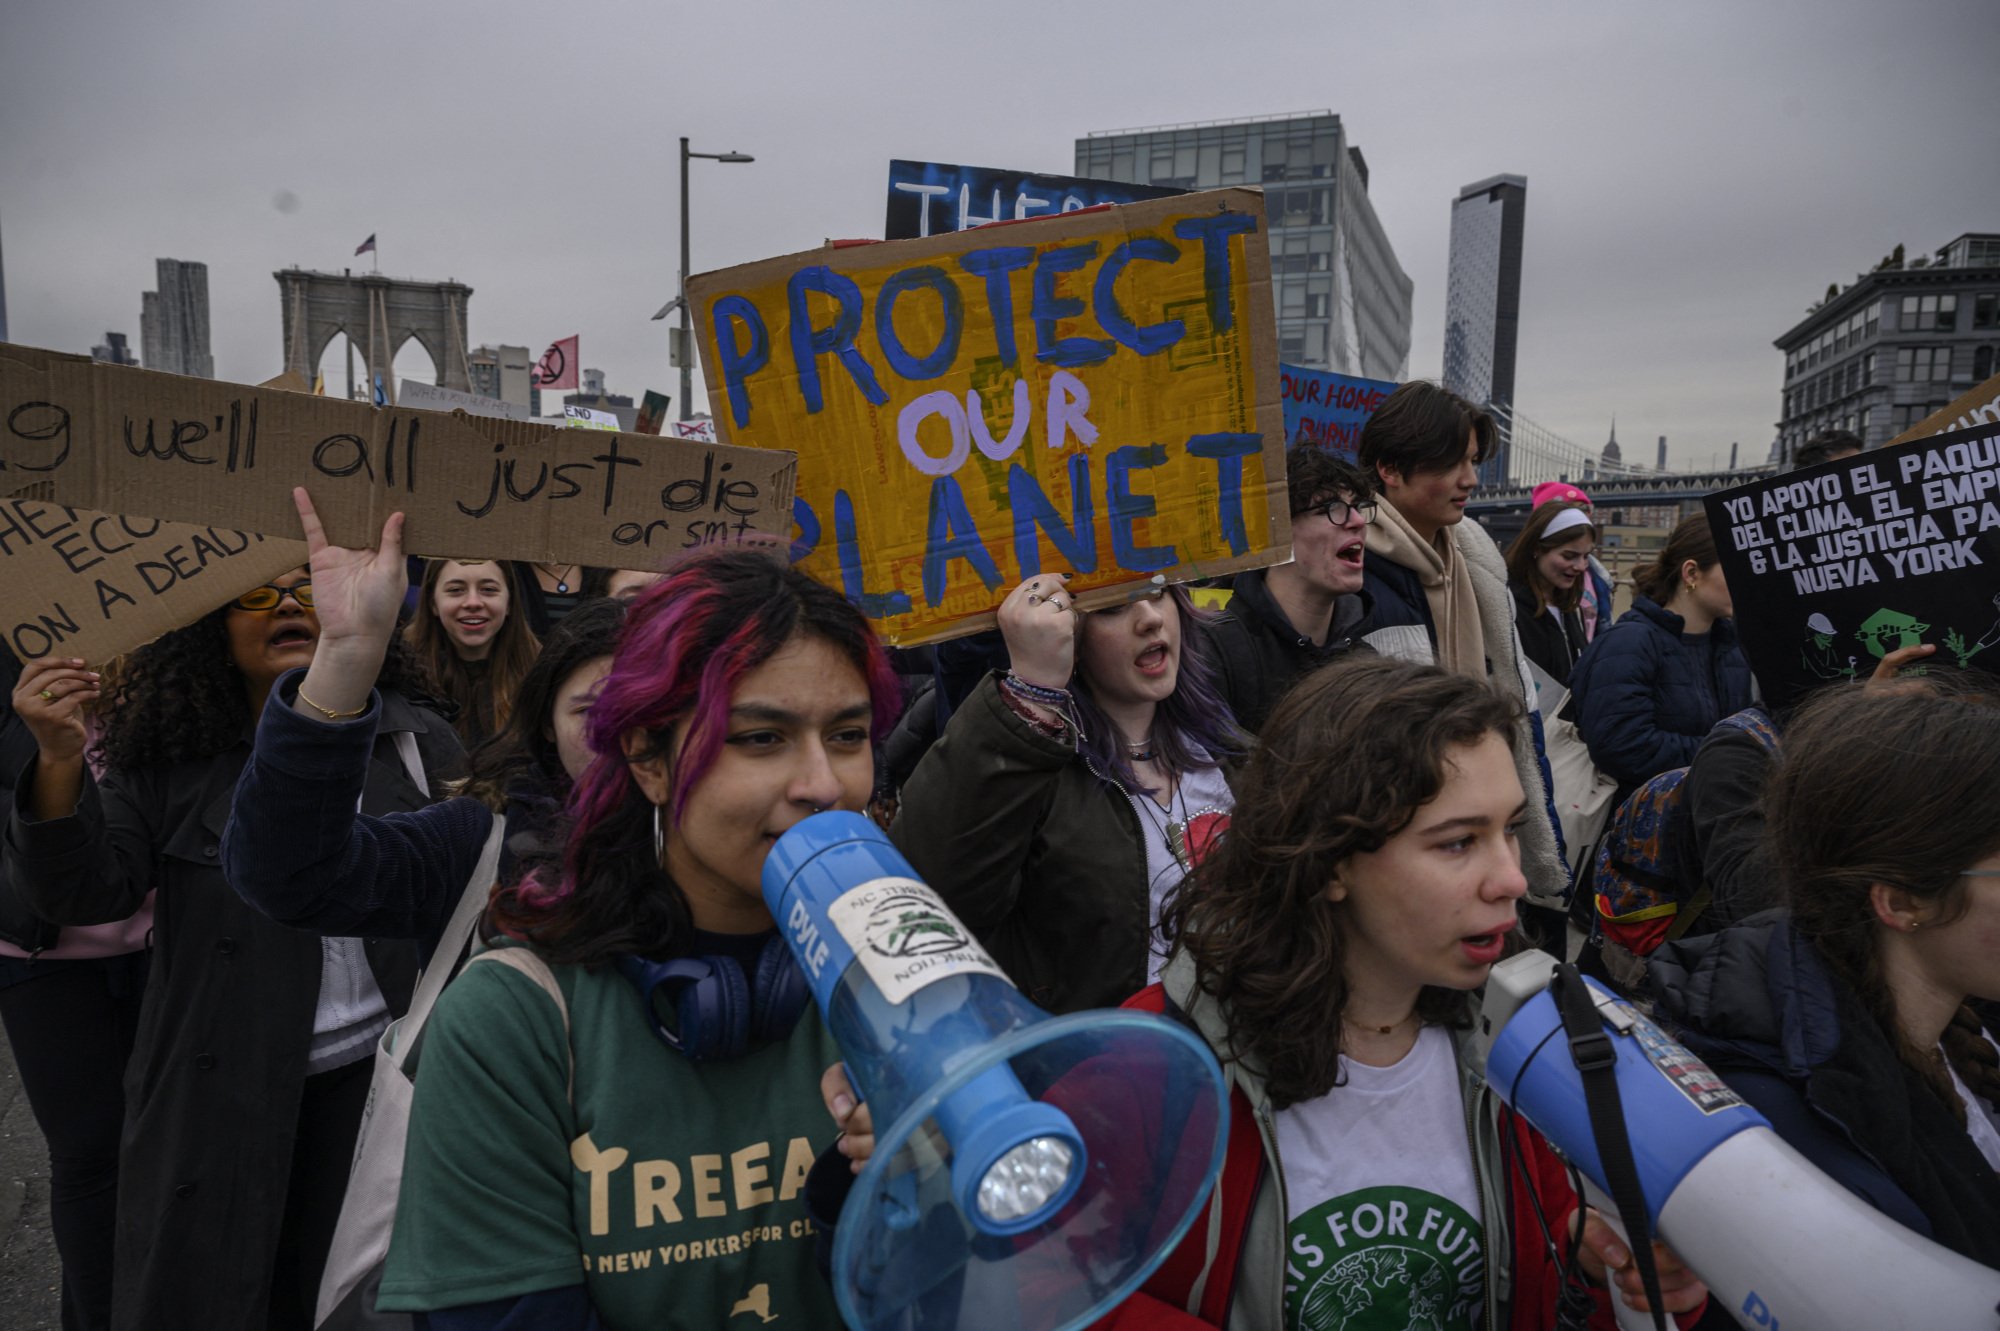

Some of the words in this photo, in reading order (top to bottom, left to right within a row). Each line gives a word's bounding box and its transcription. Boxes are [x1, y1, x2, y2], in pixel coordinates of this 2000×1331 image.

[713, 213, 1257, 430] PROTECT
[564, 406, 592, 420] END
[898, 370, 1099, 477] OUR
[1280, 373, 1320, 404] OUR
[1324, 383, 1391, 416] HOME
[124, 397, 259, 474] we'll
[312, 414, 419, 494] all
[456, 437, 643, 518] just
[661, 451, 760, 516] die
[1723, 496, 1755, 524] YO
[1763, 473, 1842, 517] APOYO
[1850, 464, 1892, 495] EL
[1731, 521, 1774, 551] DEL
[1776, 501, 1864, 541] CLIMA,
[1870, 489, 1915, 521] EL
[611, 519, 669, 548] or
[1748, 549, 1767, 575] &
[1770, 542, 1806, 571] LA
[1810, 513, 1946, 564] JUSTICIA
[12, 602, 81, 659] ON
[94, 579, 137, 619] A
[135, 526, 249, 595] DEAD
[1792, 557, 1881, 595] NUEVA
[1883, 536, 1984, 579] YORK
[788, 900, 829, 979] PYLE
[599, 1249, 652, 1274] NEW
[658, 1231, 752, 1266] YORKERS
[752, 1224, 783, 1248] FOR
[1325, 1199, 1409, 1249] FOR
